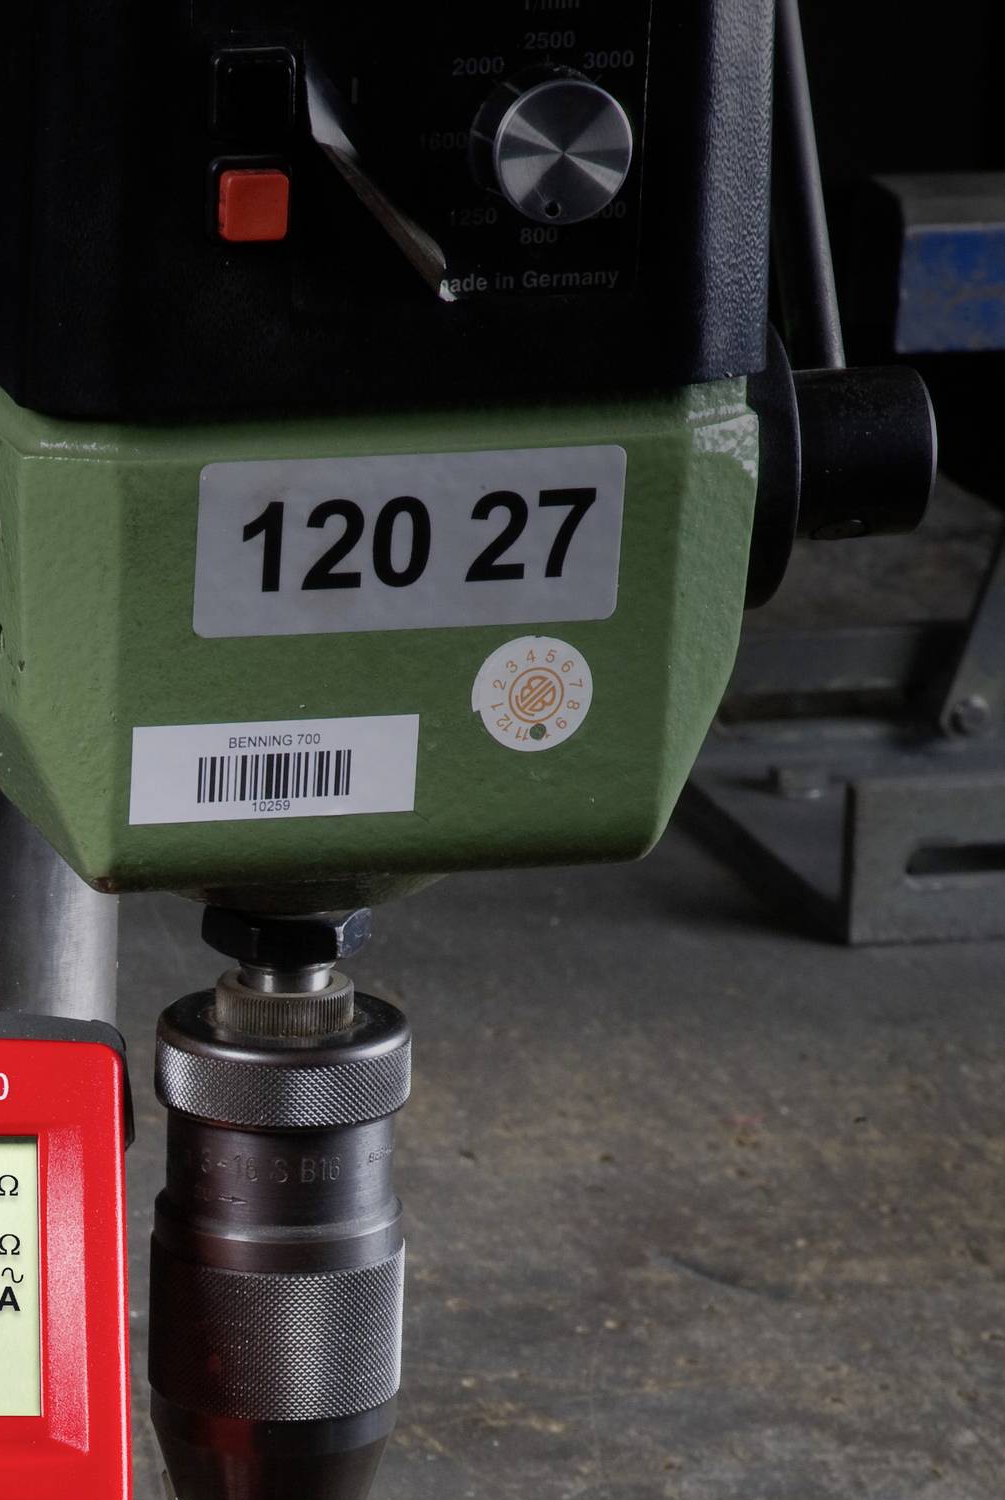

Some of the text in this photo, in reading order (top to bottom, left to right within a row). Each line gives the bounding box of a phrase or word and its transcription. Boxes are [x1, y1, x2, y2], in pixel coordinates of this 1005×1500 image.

[522, 32, 576, 49] 2500
[452, 56, 506, 76] 2000
[583, 49, 635, 69] 3000
[450, 208, 498, 226] 1250
[519, 227, 558, 245] 800
[494, 271, 514, 289] in
[522, 269, 620, 289] Germany
[243, 488, 596, 592] 120 27
[493, 679, 507, 690] 2
[506, 660, 518, 673] 3
[527, 649, 536, 662] 4
[545, 649, 557, 663] 5
[567, 700, 579, 710] 8
[229, 733, 320, 748] BENNING 700
[252, 800, 290, 811] 10259
[301, 1156, 341, 1181] B16
